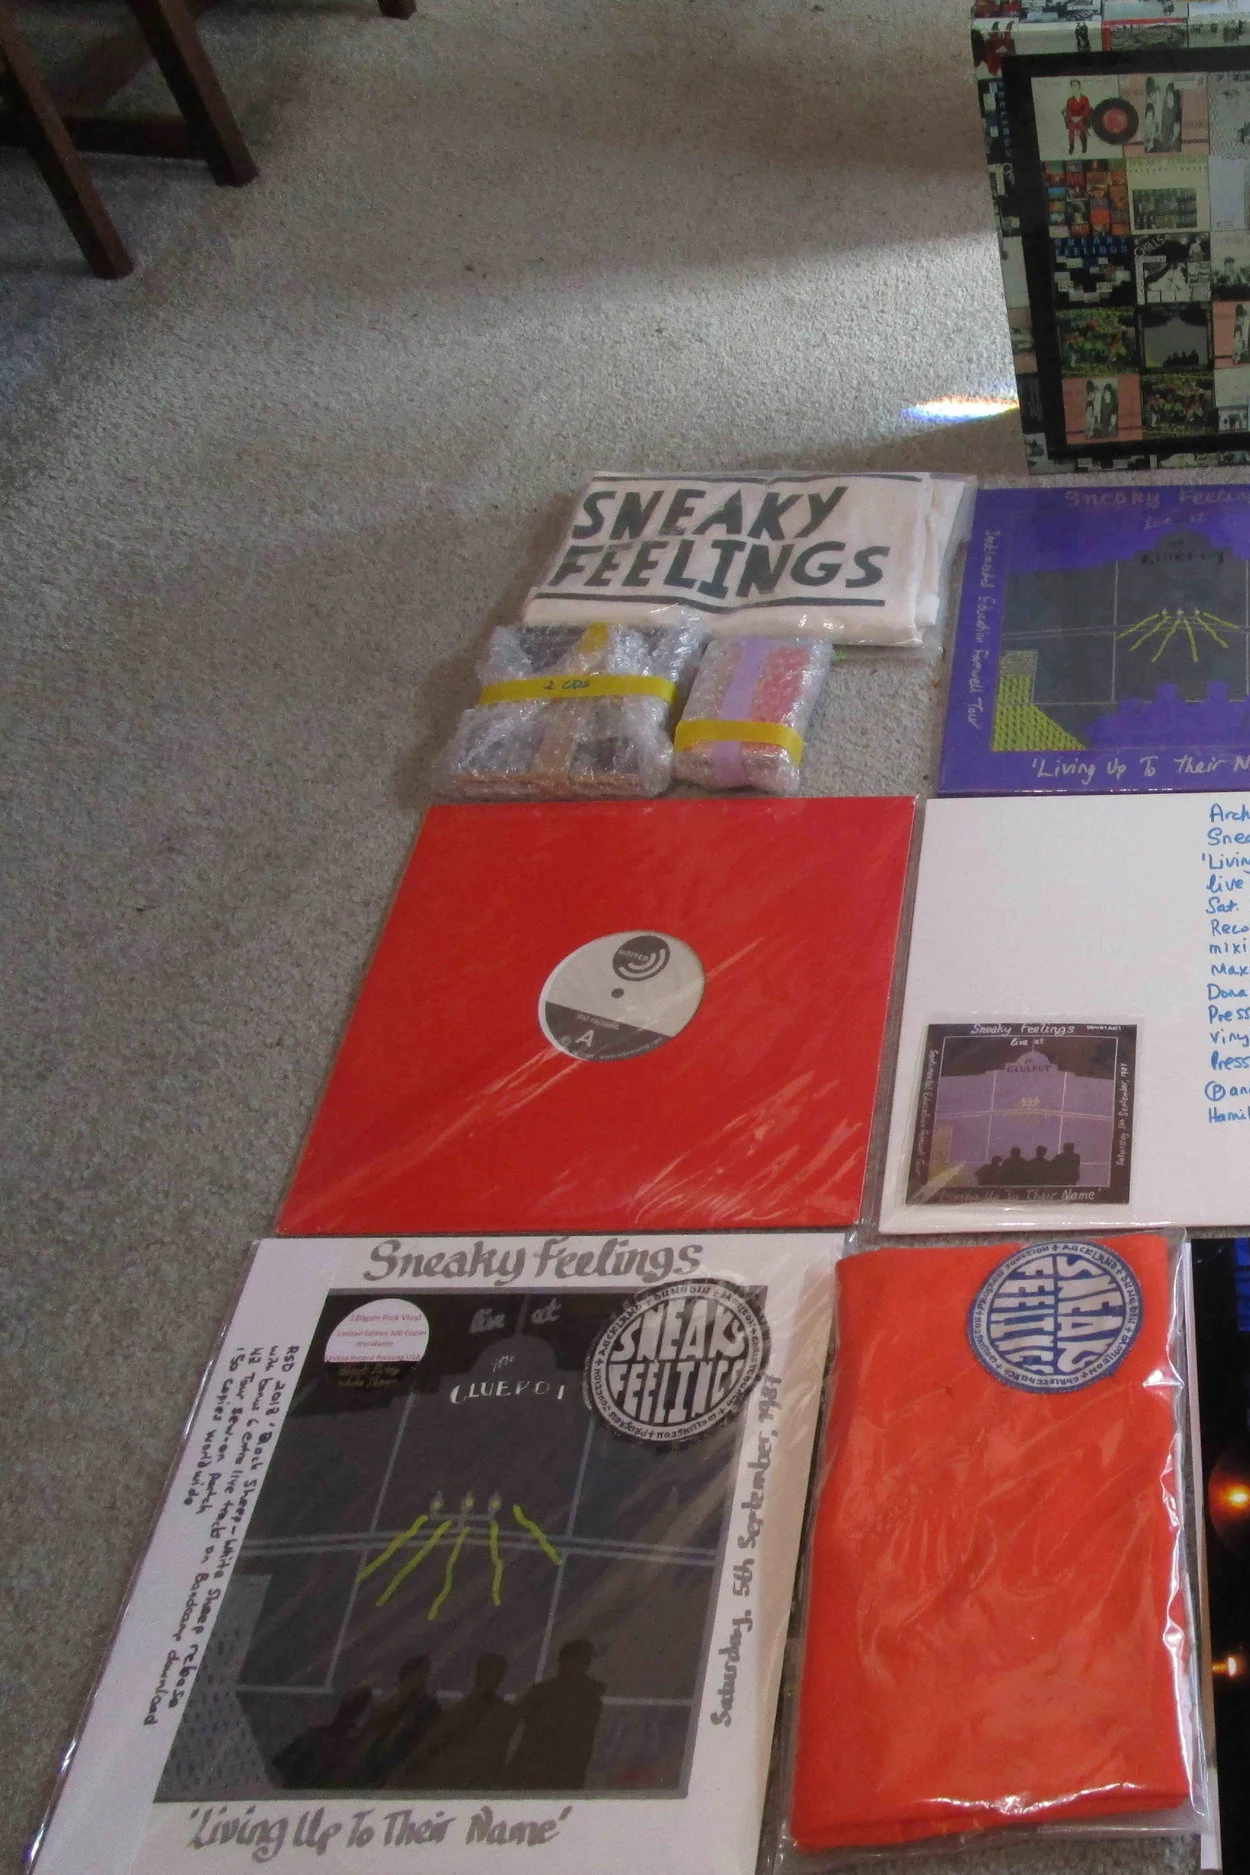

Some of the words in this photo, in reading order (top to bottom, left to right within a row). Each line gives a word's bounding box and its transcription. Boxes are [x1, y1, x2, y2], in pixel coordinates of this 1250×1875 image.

[572, 486, 848, 541] SNEAKY
[548, 540, 890, 598] FEELINGS
[1107, 758, 1127, 779] Up
[1140, 756, 1159, 776] To
[1175, 754, 1227, 774] Their
[575, 1029, 595, 1047] A
[970, 1023, 1012, 1035] Sneaky
[1021, 1023, 1075, 1036] Feelings
[363, 1239, 526, 1286] Sneaky
[533, 1236, 703, 1283] Feelings
[531, 1298, 562, 1324] at
[282, 1345, 299, 1372] RSD
[237, 1372, 255, 1400] Tour
[247, 1419, 259, 1428] 6
[225, 1470, 243, 1494] live
[201, 1546, 214, 1563] on
[732, 1557, 755, 1597] 5th
[192, 1588, 221, 1634] Sheep
[293, 1807, 342, 1856] Up
[347, 1809, 377, 1849] To
[383, 1809, 456, 1847] Their
